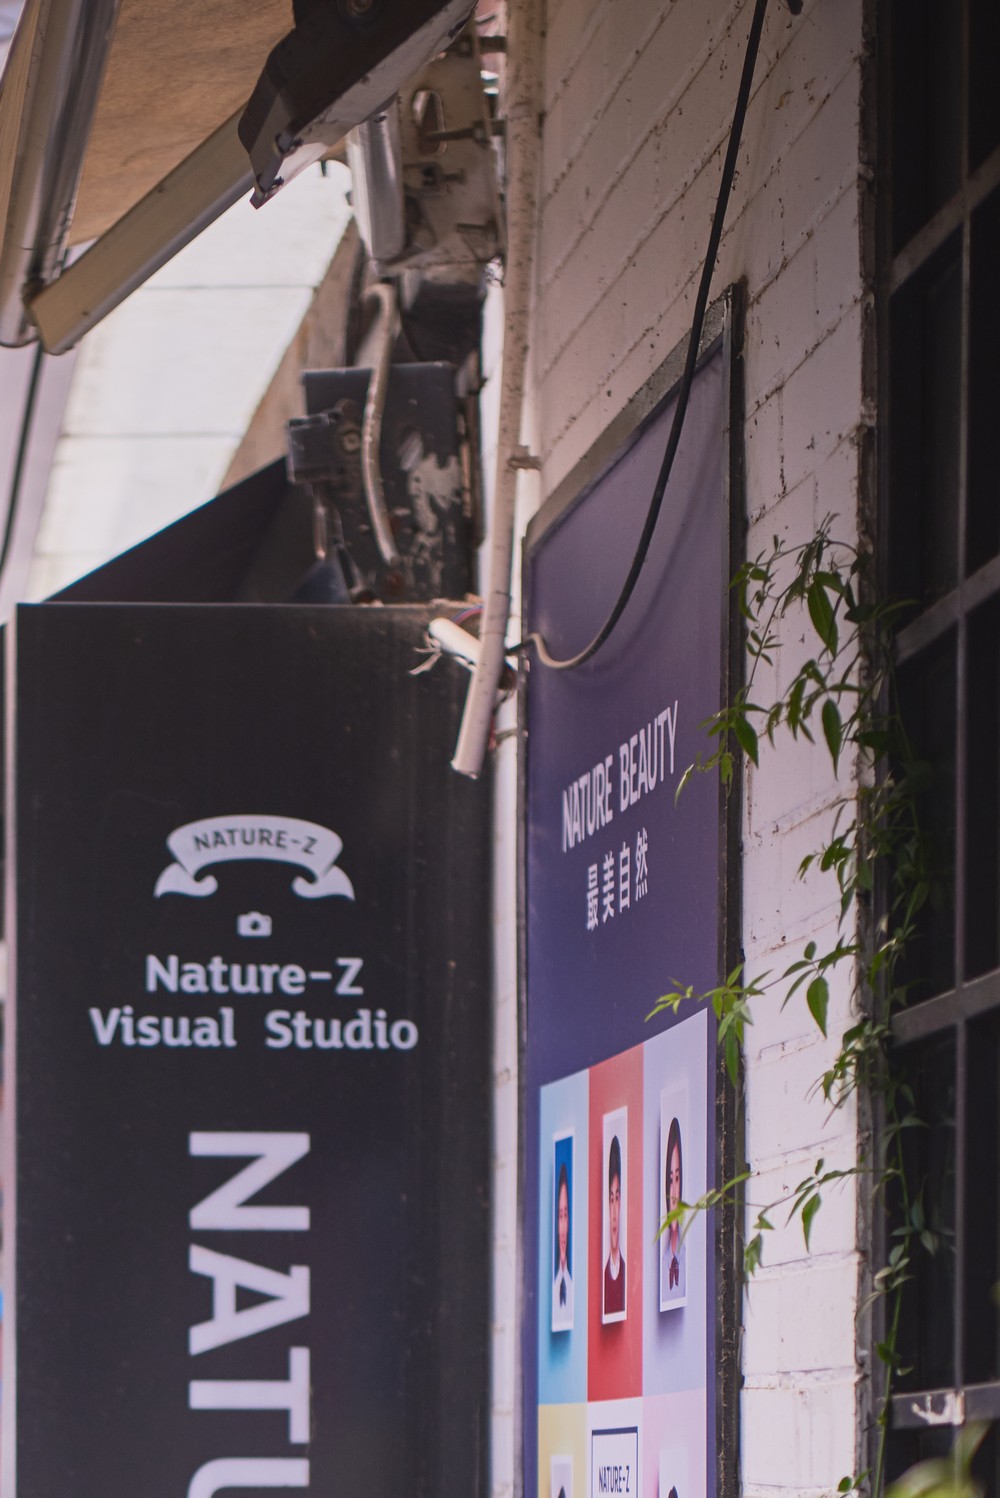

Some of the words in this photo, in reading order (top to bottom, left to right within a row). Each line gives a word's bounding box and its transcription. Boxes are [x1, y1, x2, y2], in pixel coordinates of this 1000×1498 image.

[562, 754, 614, 853] NATURE
[619, 700, 679, 812] BEAUTY
[193, 827, 318, 855] NATURE-Z
[586, 827, 649, 931] 最美自然
[145, 954, 364, 996] Nature-Z
[89, 1005, 237, 1048] Visual
[264, 1008, 419, 1050] Studio
[598, 1465, 630, 1493] NATURE-Z
